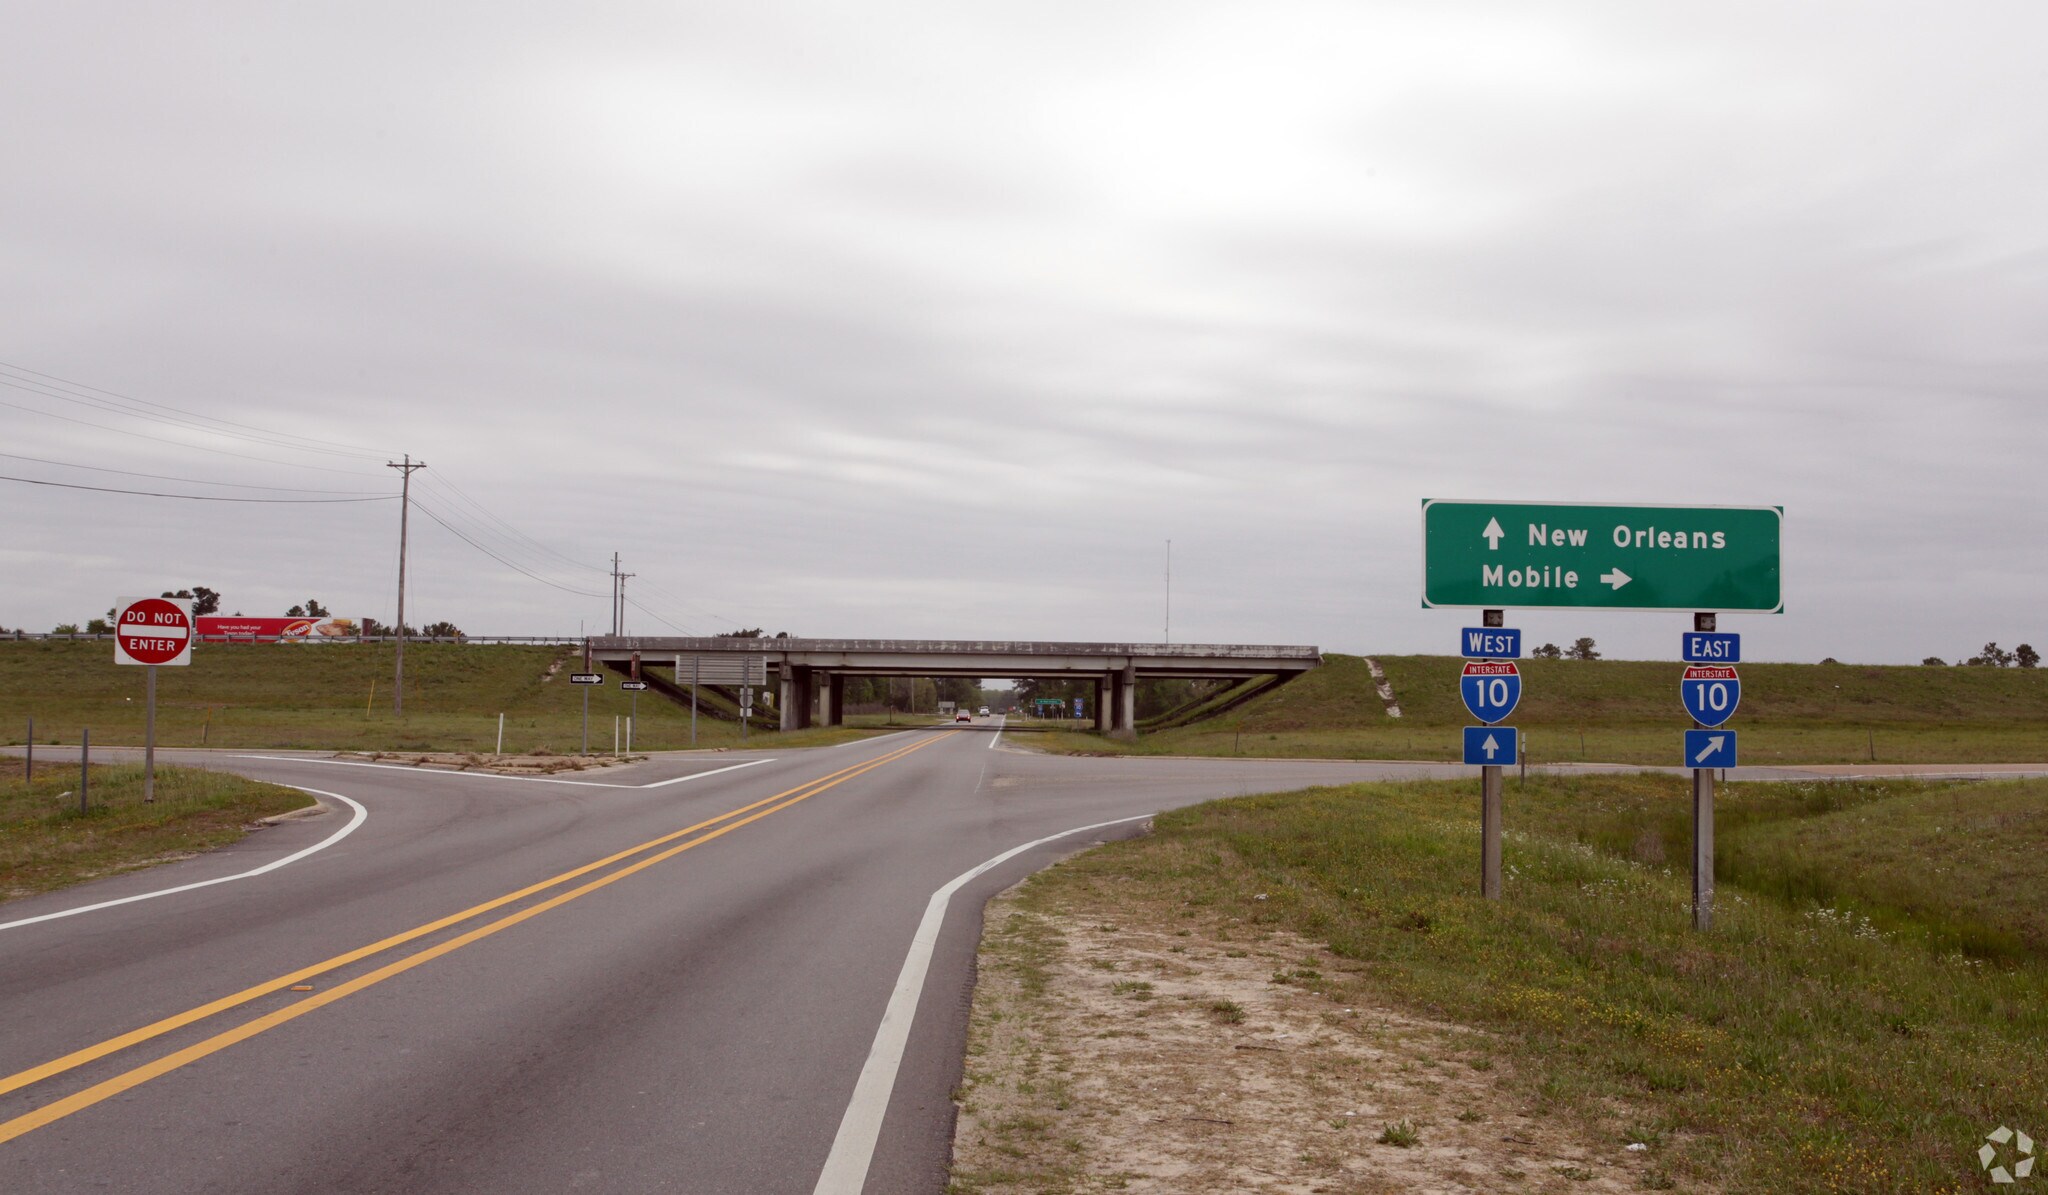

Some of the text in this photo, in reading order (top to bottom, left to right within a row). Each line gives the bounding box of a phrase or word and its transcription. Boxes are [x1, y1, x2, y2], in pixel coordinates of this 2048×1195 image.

[1528, 523, 1727, 549] New Orleans
[1482, 564, 1579, 588] Mobile
[127, 611, 182, 624] DO NOT
[285, 624, 310, 636] Tyson
[129, 638, 175, 651] ENTER
[1469, 632, 1514, 653] WEST
[1691, 637, 1731, 657] EAST
[1469, 665, 1511, 674] INTERSTATE
[1690, 670, 1730, 678] INTERSTATE
[1476, 678, 1508, 708] 10
[1697, 683, 1728, 711] 10
